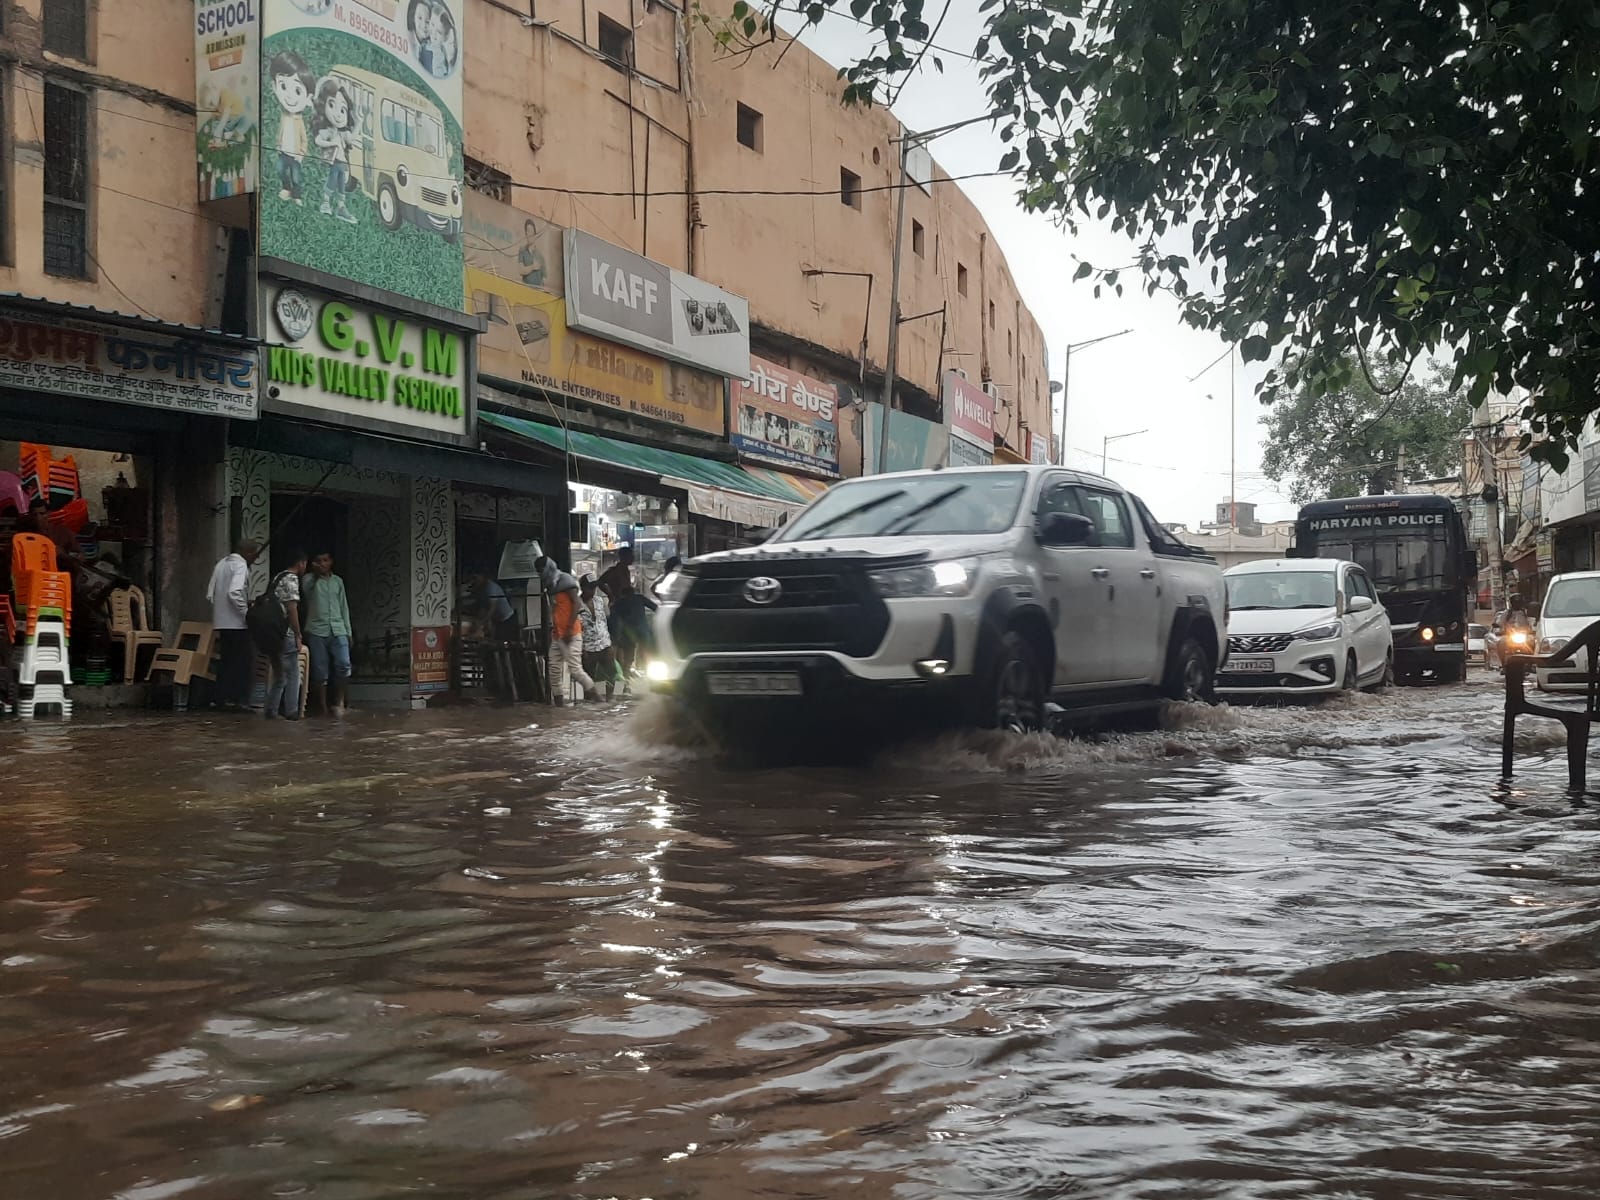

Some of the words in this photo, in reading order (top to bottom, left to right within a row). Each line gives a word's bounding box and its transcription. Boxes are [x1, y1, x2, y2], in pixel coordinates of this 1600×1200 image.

[198, 0, 256, 36] SCHOOL
[334, 4, 346, 23] M.
[349, 11, 409, 54] 8950628330
[591, 257, 659, 315] KAFF
[268, 346, 317, 387] KIDS
[319, 356, 390, 403] VALLEY
[393, 374, 465, 419] SCHOOL
[521, 369, 559, 391] NAGPAL
[561, 380, 622, 407] ENTERPRISES
[964, 395, 992, 429] HAVELLS
[1310, 517, 1382, 531] HARYANA
[1388, 514, 1444, 526] POLICE
